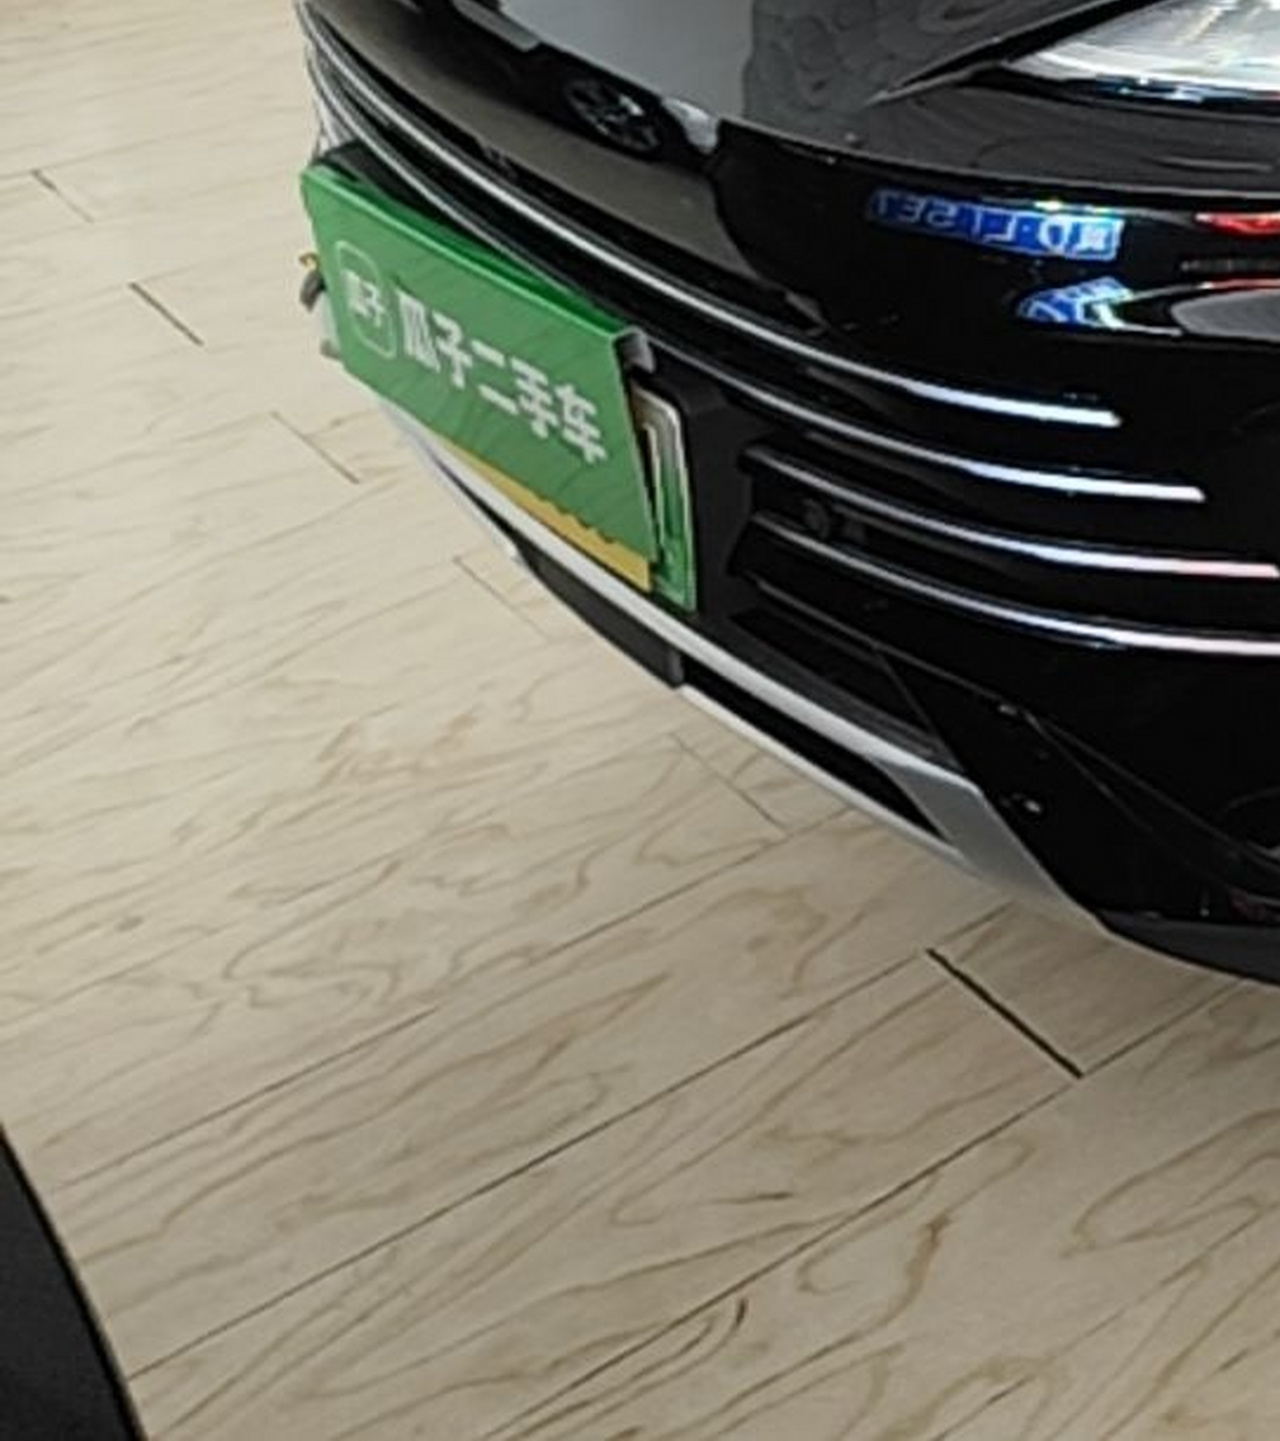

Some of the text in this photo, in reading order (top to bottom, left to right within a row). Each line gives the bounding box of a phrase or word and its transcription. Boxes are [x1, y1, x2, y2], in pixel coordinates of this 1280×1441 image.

[395, 286, 608, 464] 瓜子二手车
